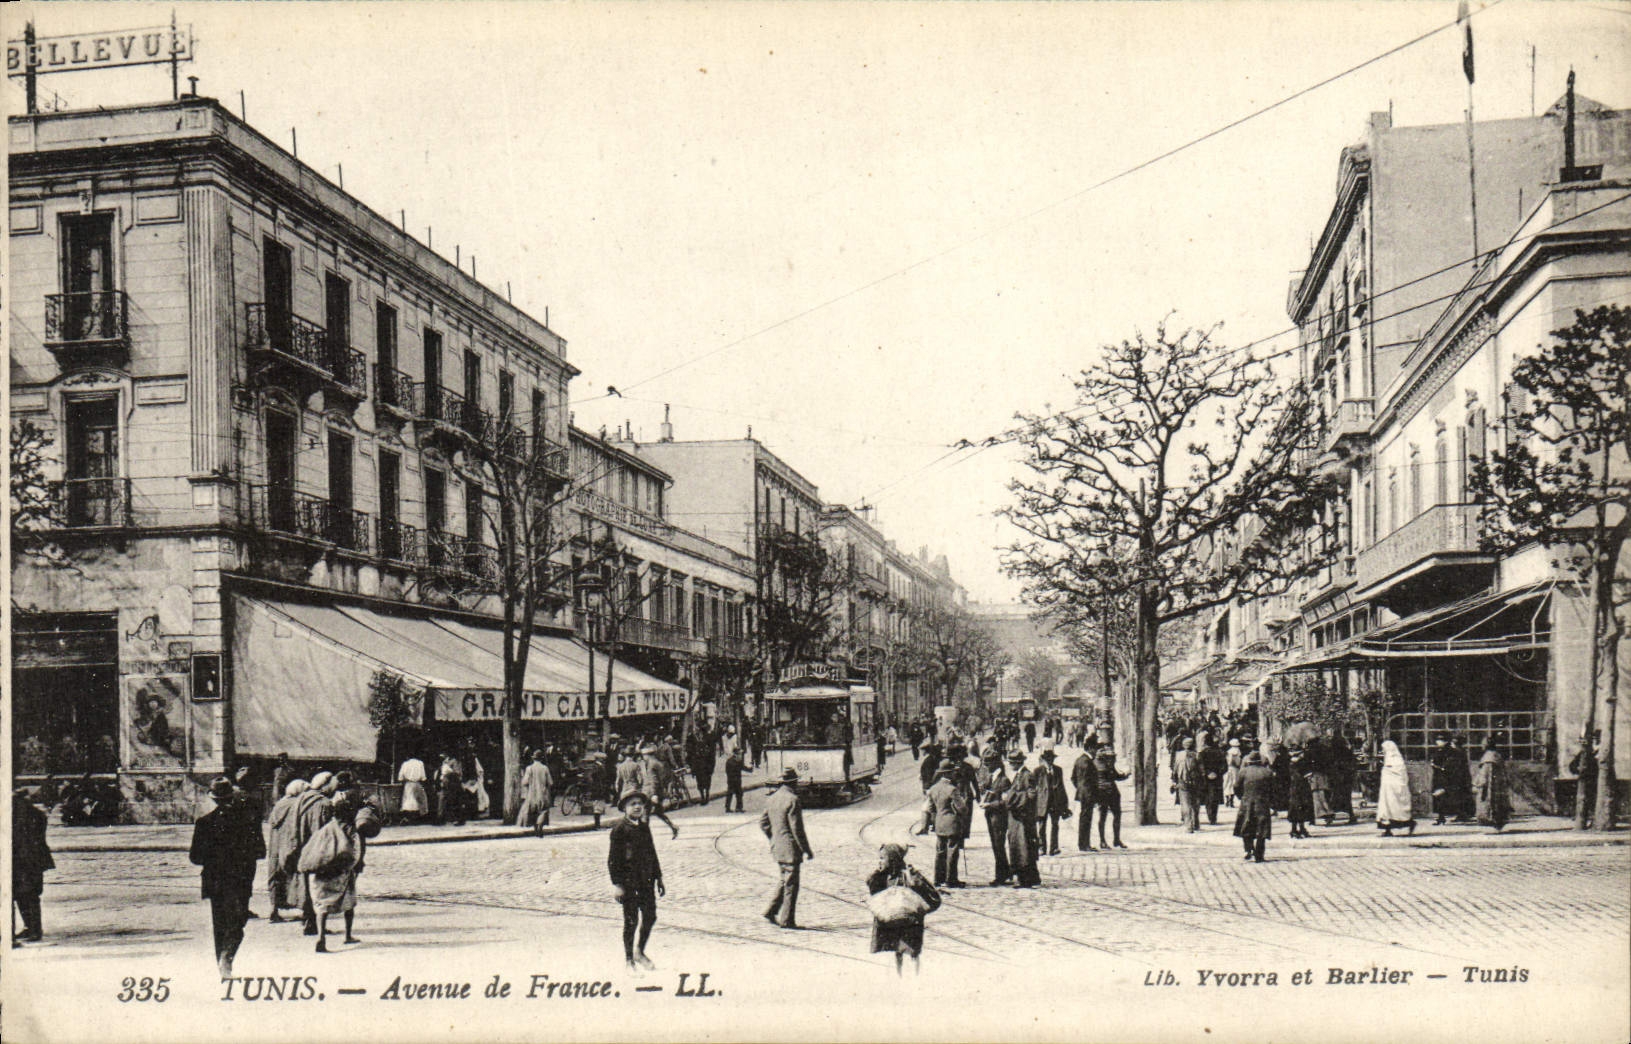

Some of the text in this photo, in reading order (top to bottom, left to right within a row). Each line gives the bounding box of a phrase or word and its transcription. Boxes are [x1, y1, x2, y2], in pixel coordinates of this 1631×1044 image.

[8, 32, 185, 70] BELLEVUE
[557, 695, 609, 717] CAE
[617, 694, 637, 714] DE
[644, 692, 687, 712] TUNIS
